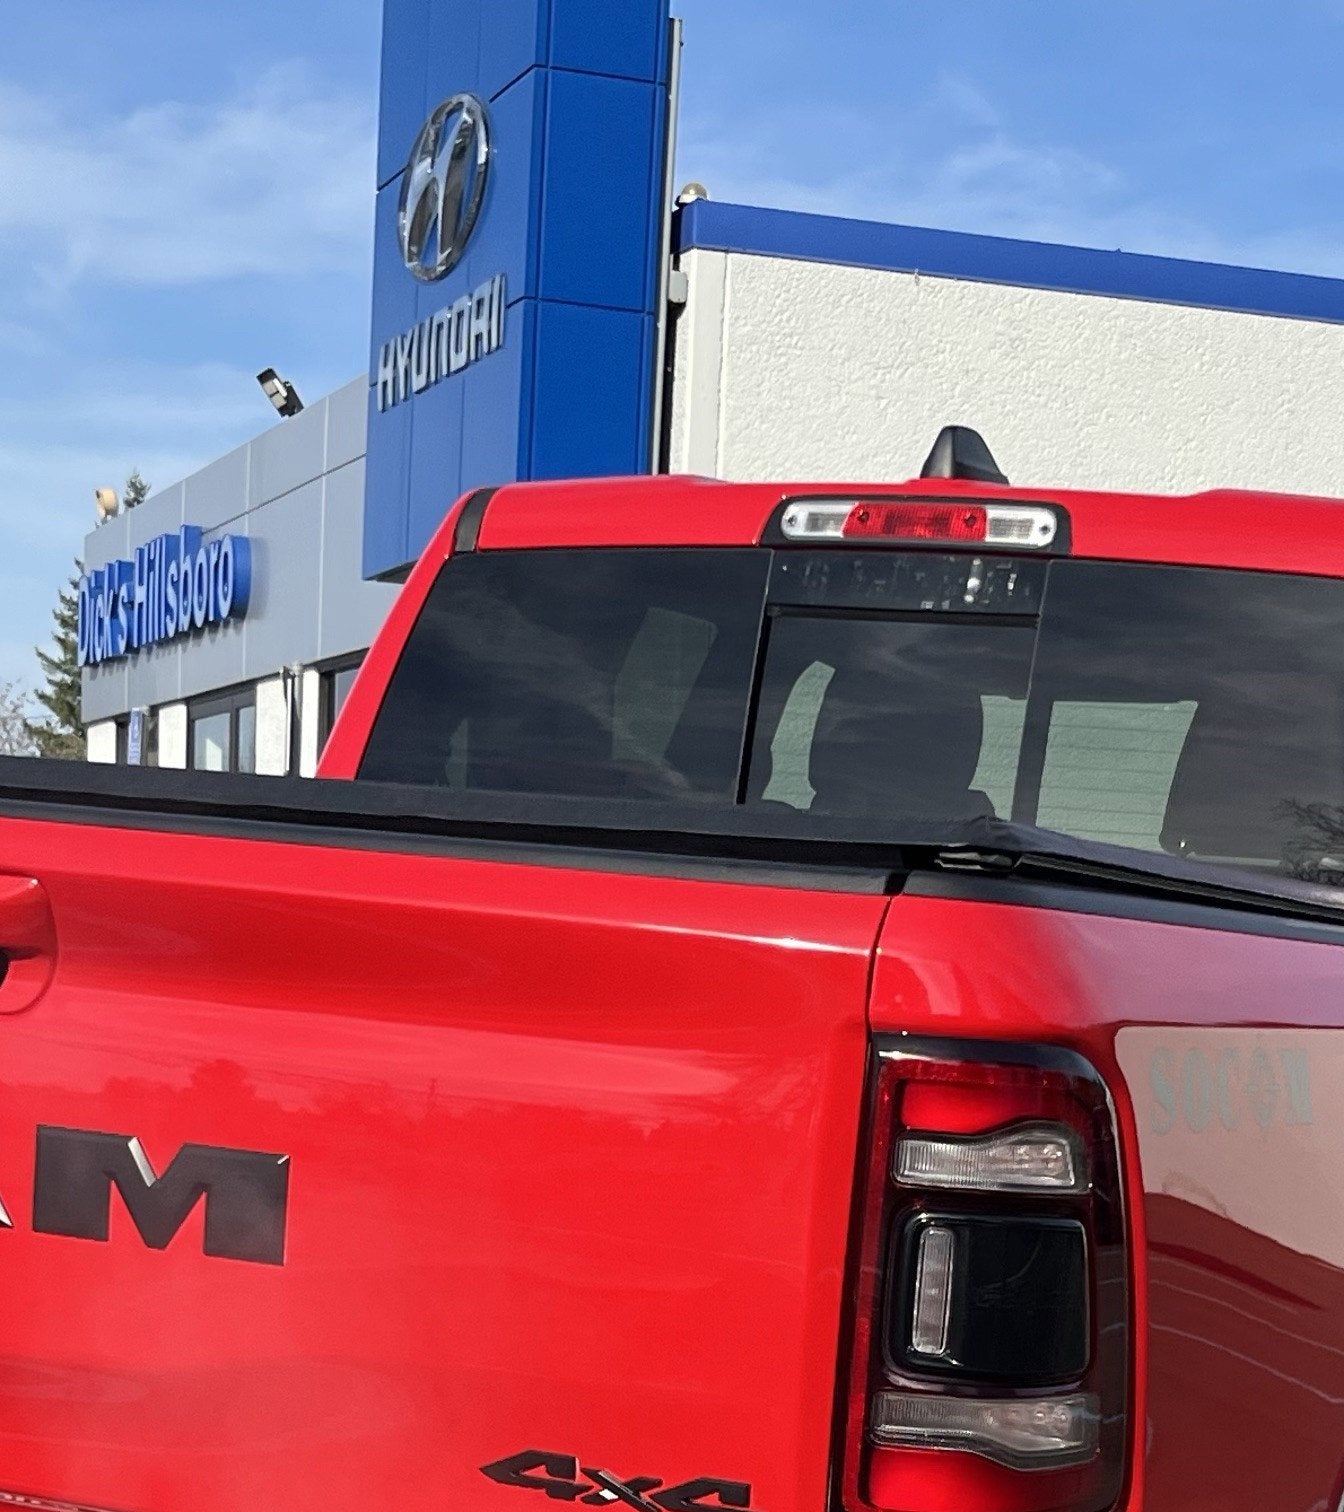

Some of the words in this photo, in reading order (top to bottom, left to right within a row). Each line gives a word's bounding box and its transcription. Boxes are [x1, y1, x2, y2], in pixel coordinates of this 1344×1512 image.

[377, 272, 507, 413] HYUNDAI
[77, 560, 130, 668] Dick's
[130, 524, 237, 650] Hillsboro
